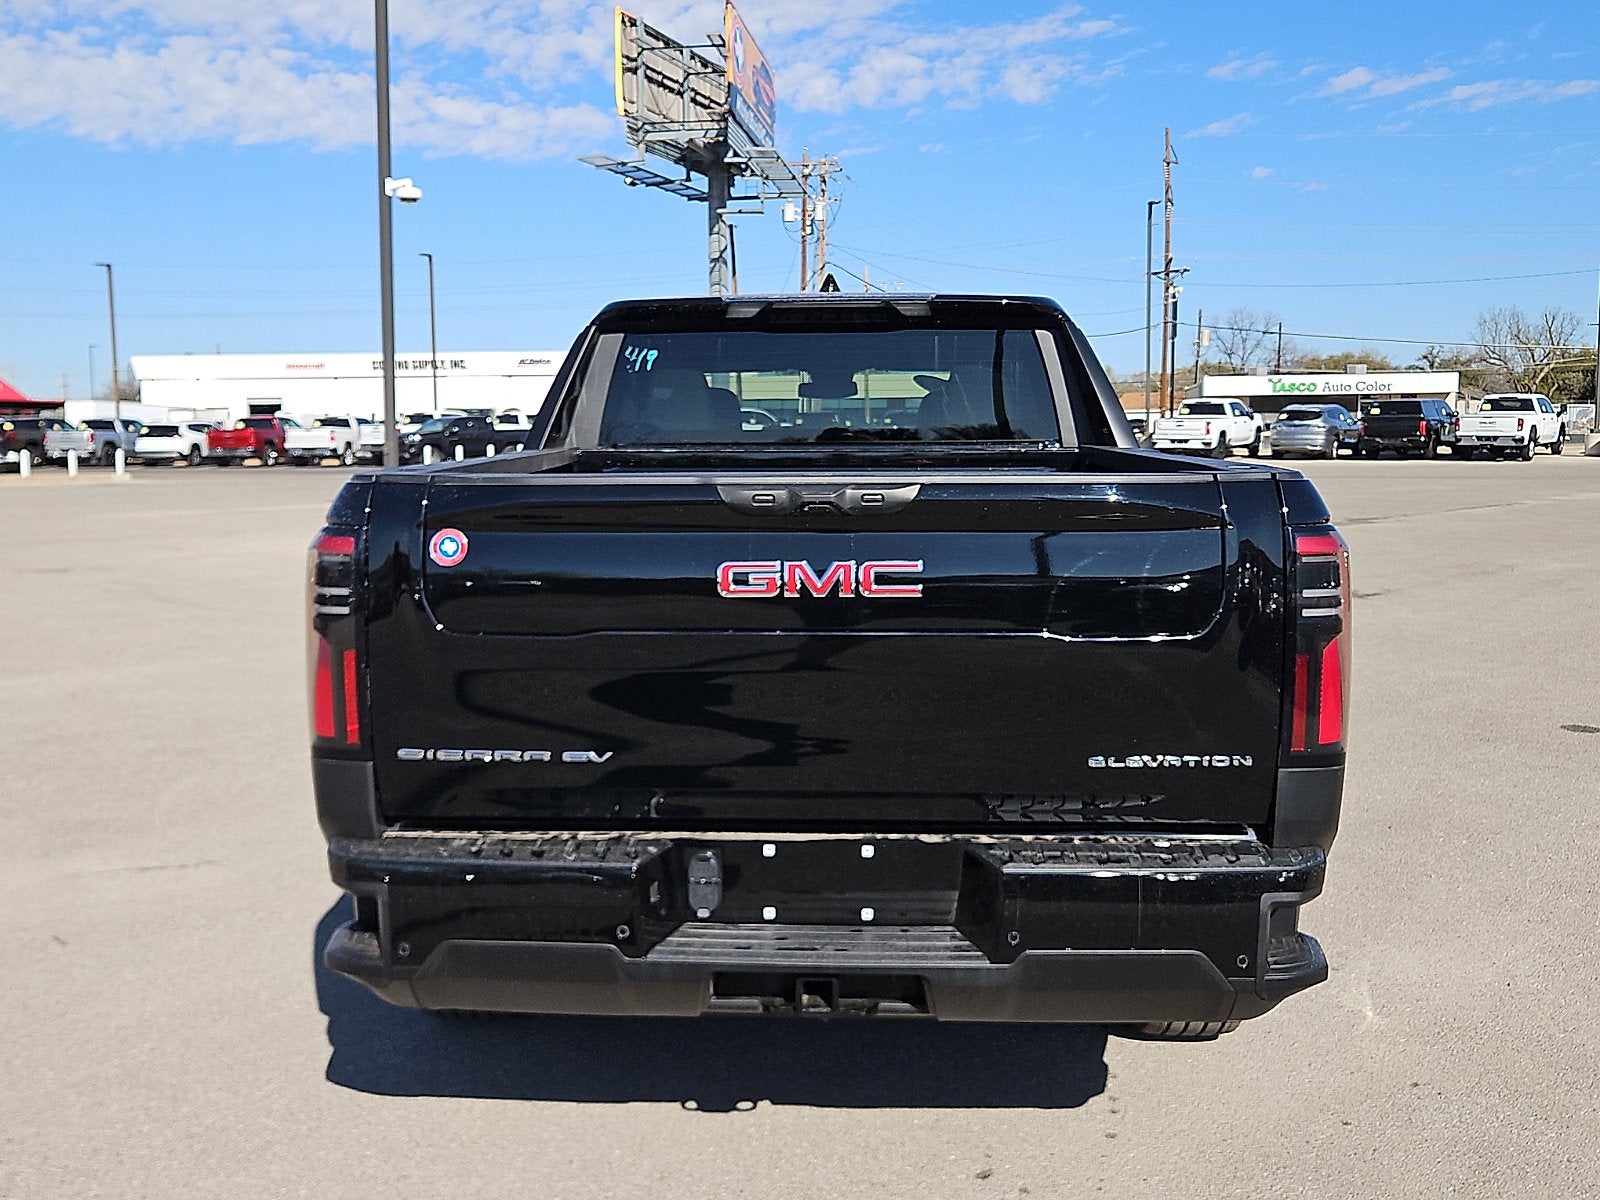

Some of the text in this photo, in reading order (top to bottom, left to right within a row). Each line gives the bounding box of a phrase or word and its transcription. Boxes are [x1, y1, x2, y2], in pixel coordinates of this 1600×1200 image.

[1321, 381, 1352, 393] Auto
[1355, 380, 1393, 392] Color
[716, 559, 925, 598] GMC
[396, 747, 614, 764] SIERRA EV
[1087, 754, 1254, 768] ELEVATION
